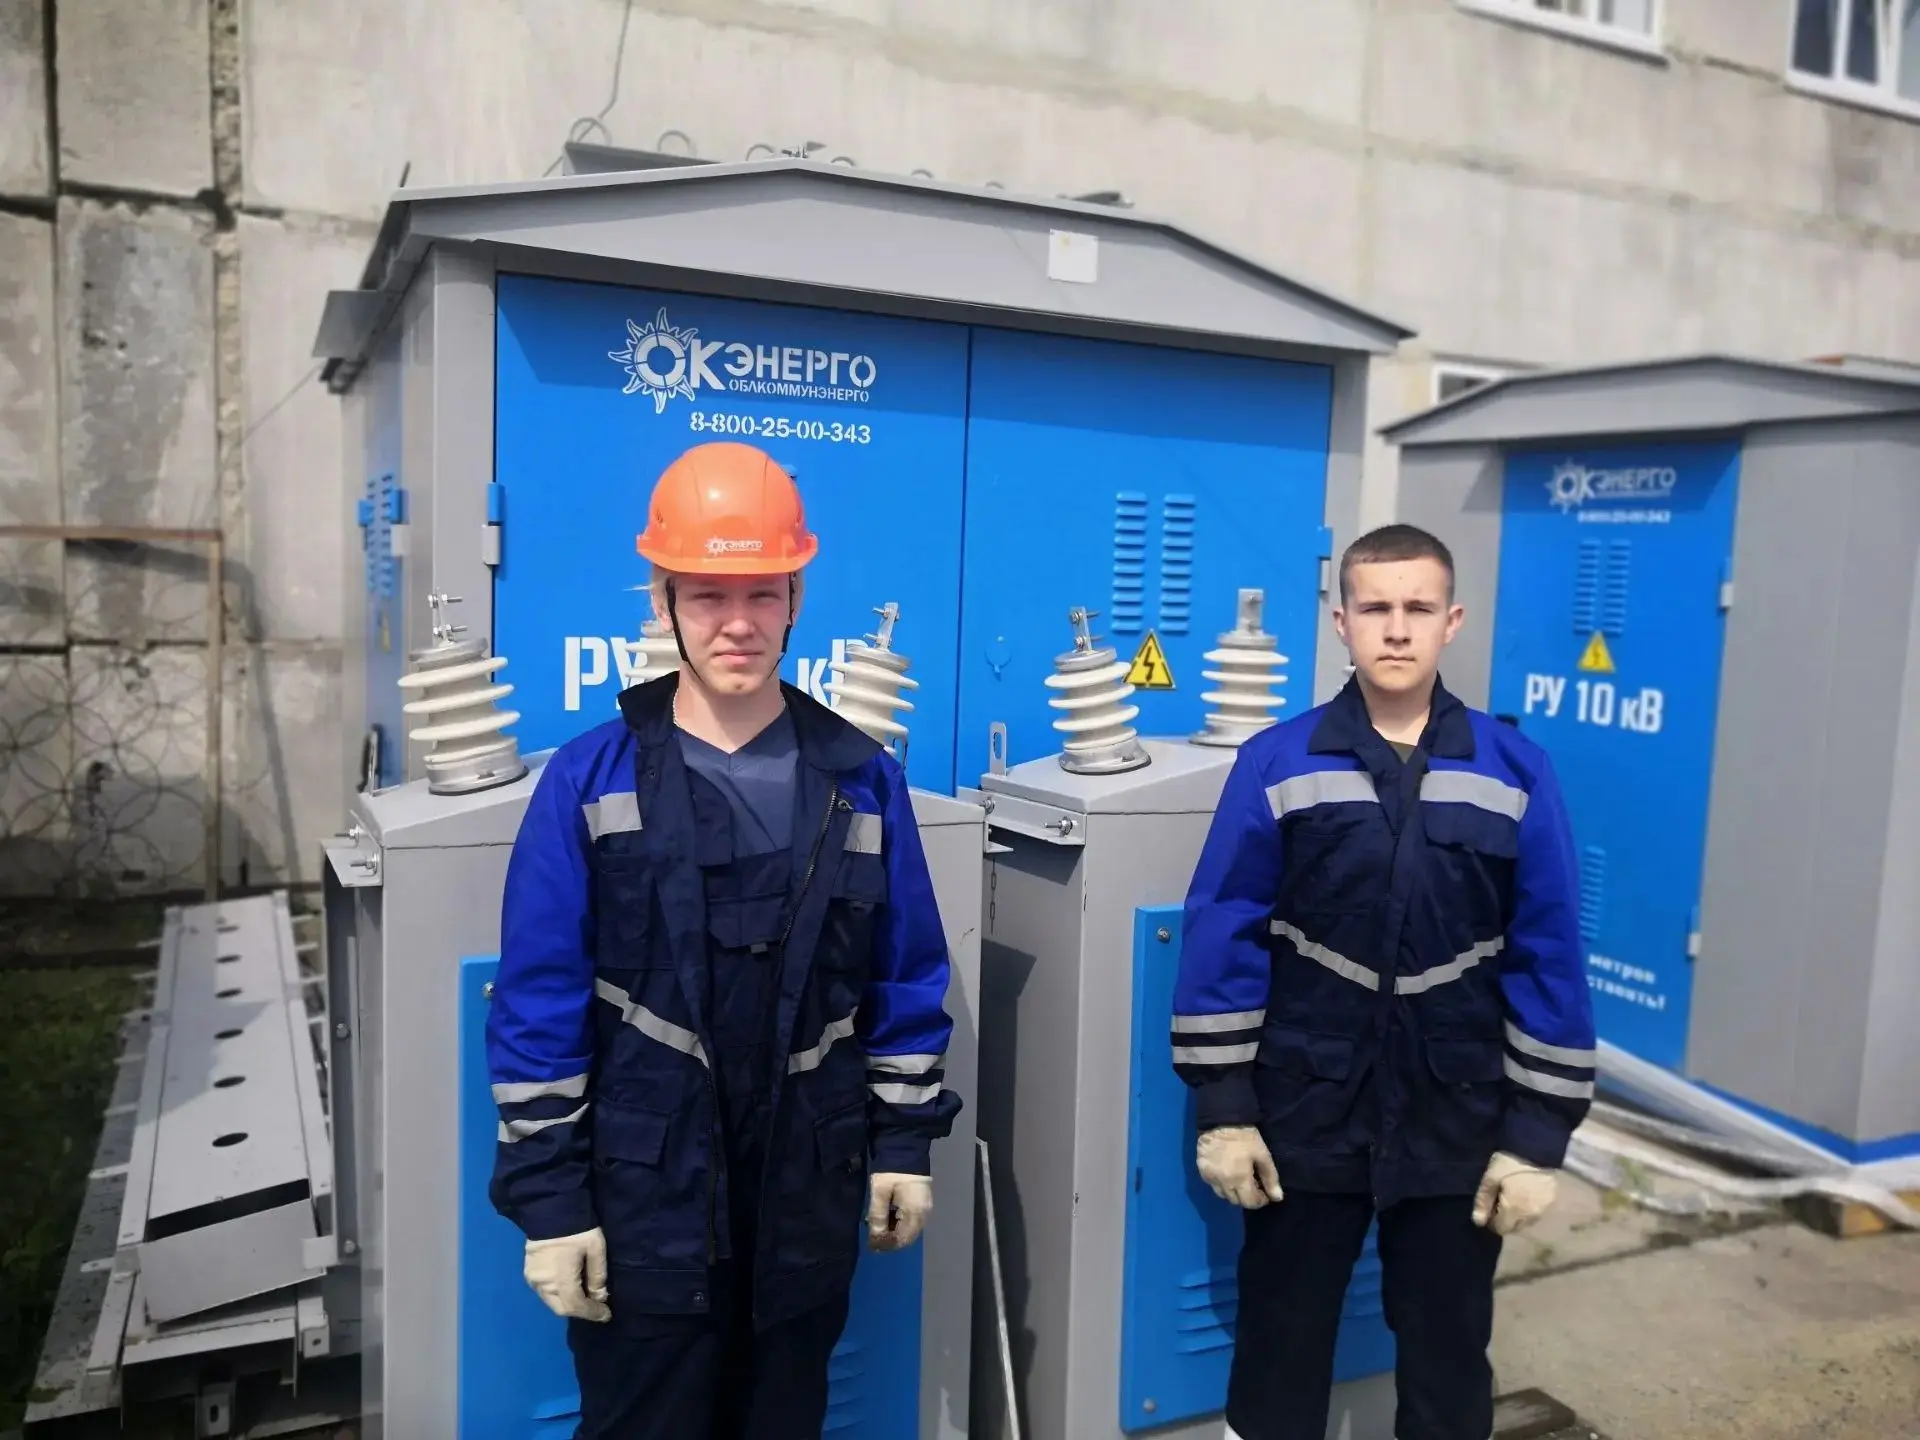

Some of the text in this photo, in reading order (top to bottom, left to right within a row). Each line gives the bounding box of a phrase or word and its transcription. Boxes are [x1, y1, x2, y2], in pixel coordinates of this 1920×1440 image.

[729, 379, 870, 403] ОБЛКОММУНЭНЕРГО
[690, 411, 872, 445] 8-800-25-00-343
[1524, 673, 1664, 733] РУ 10 кВ
